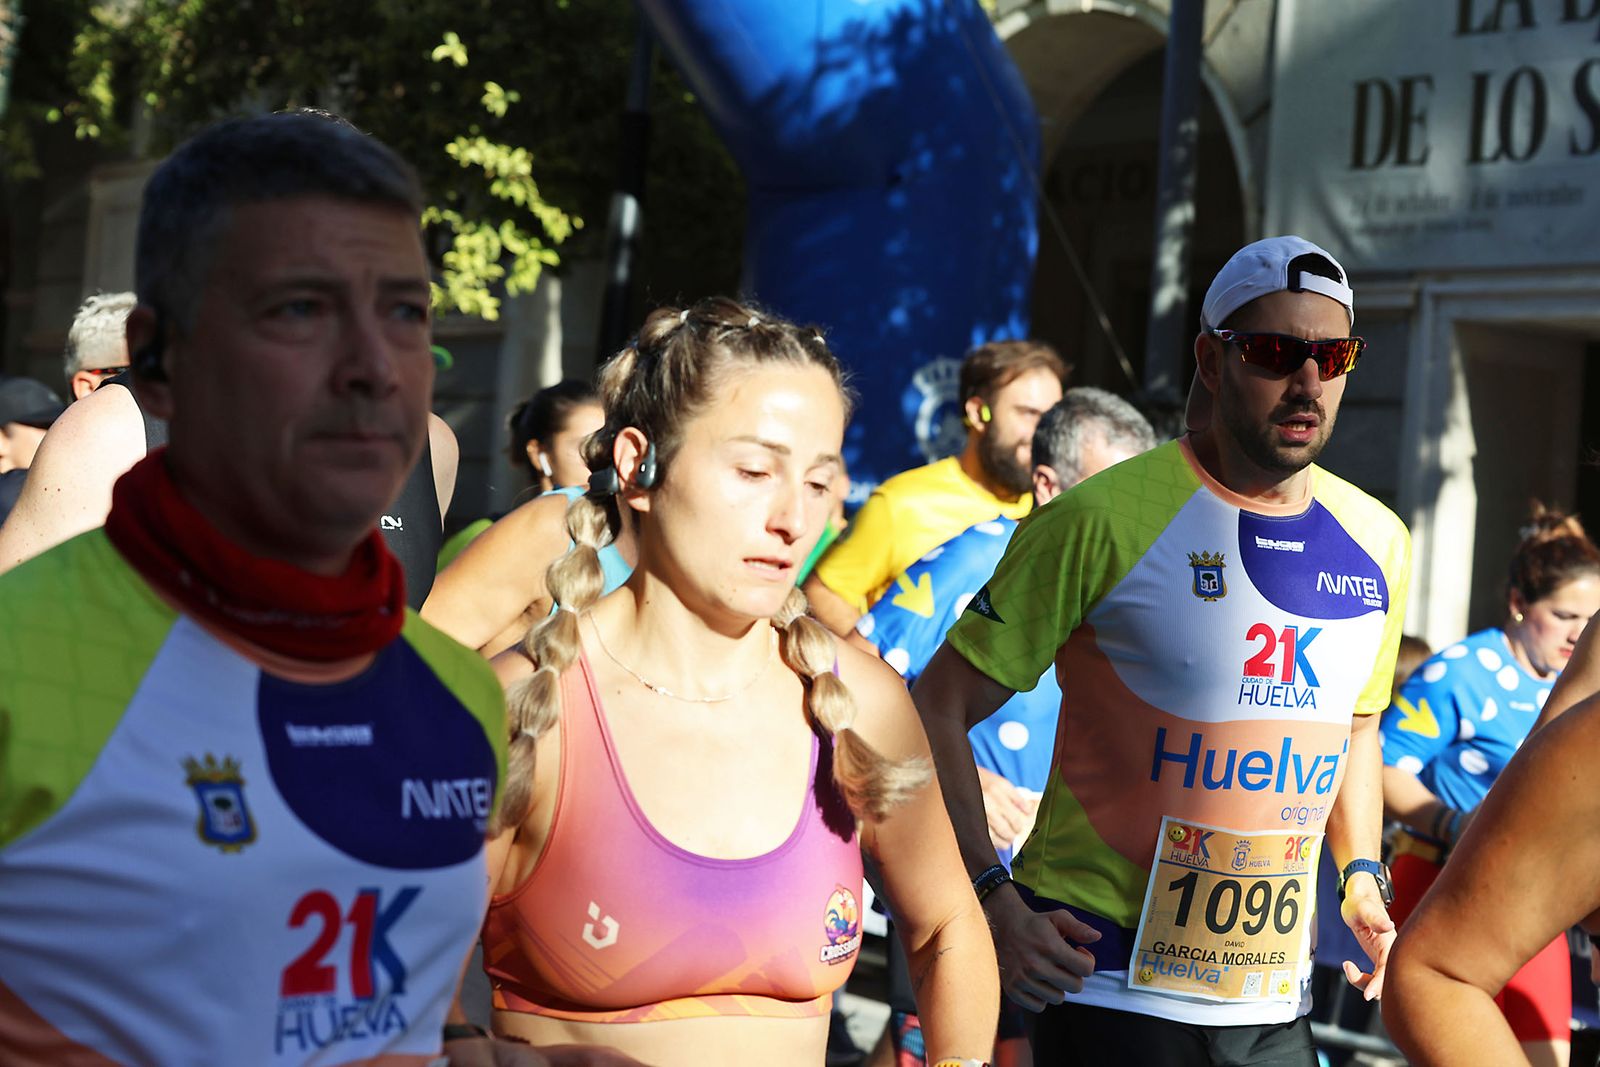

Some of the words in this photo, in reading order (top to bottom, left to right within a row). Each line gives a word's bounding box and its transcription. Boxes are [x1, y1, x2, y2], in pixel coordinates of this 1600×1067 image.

[1351, 73, 1436, 171] DE
[1467, 65, 1548, 165] LO
[1316, 571, 1383, 600] AVATEL
[1243, 622, 1323, 688] 21K
[1238, 683, 1317, 710] HUELVA
[1151, 727, 1336, 795] Huelva
[401, 778, 491, 818] AVATE
[1170, 850, 1210, 868] HUELVA
[1168, 871, 1301, 936] 1096
[279, 885, 424, 1001] 21K
[1152, 941, 1217, 964] GARCIA
[1221, 951, 1286, 966] MORALES
[1224, 940, 1245, 949] DAVID
[1142, 953, 1221, 983] Huelva
